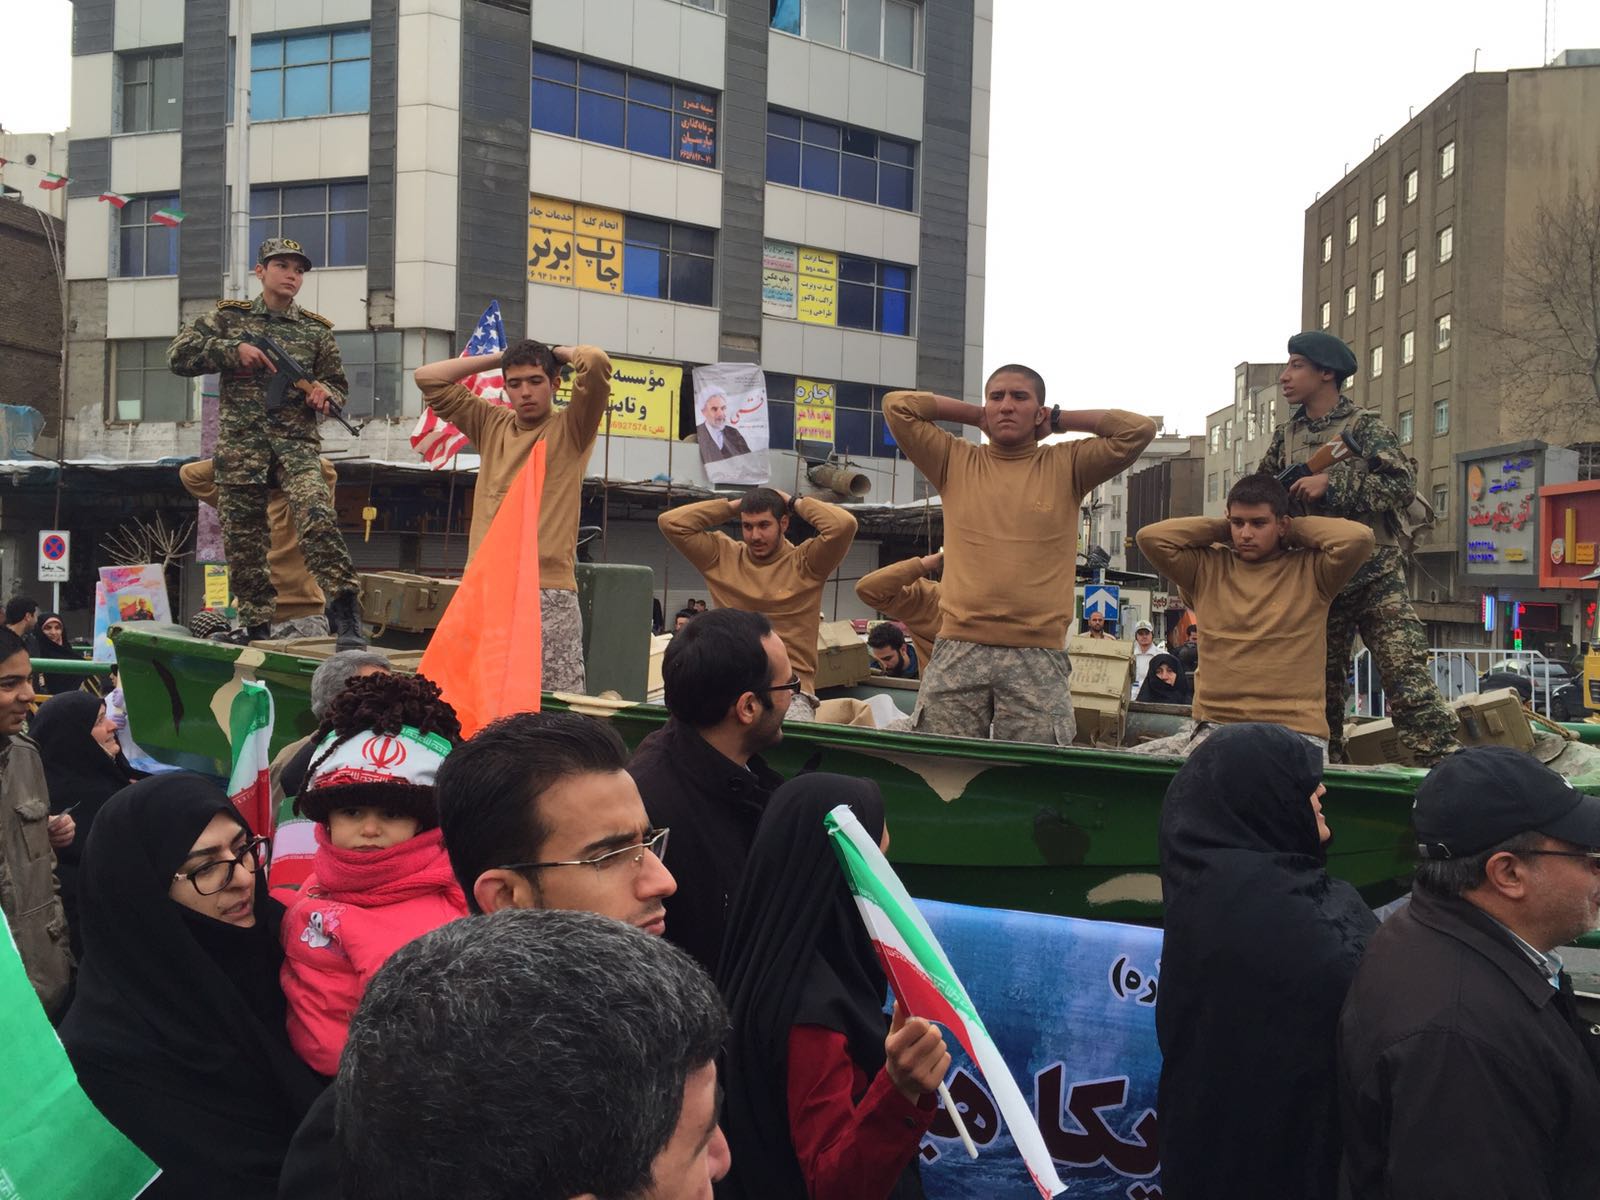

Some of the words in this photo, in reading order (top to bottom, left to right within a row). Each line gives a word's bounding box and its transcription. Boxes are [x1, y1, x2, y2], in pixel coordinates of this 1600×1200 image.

[545, 210, 573, 221] خدمات
[582, 217, 597, 226] کلیه
[599, 219, 618, 231] انجام
[528, 228, 571, 270] برتر
[576, 238, 620, 290] چاپ
[816, 284, 833, 292] کارت
[813, 309, 832, 318] طراحی
[613, 369, 665, 392] مؤسسه
[796, 385, 833, 404] اجاره
[638, 405, 647, 420] و
[609, 421, 647, 432] 6927574
